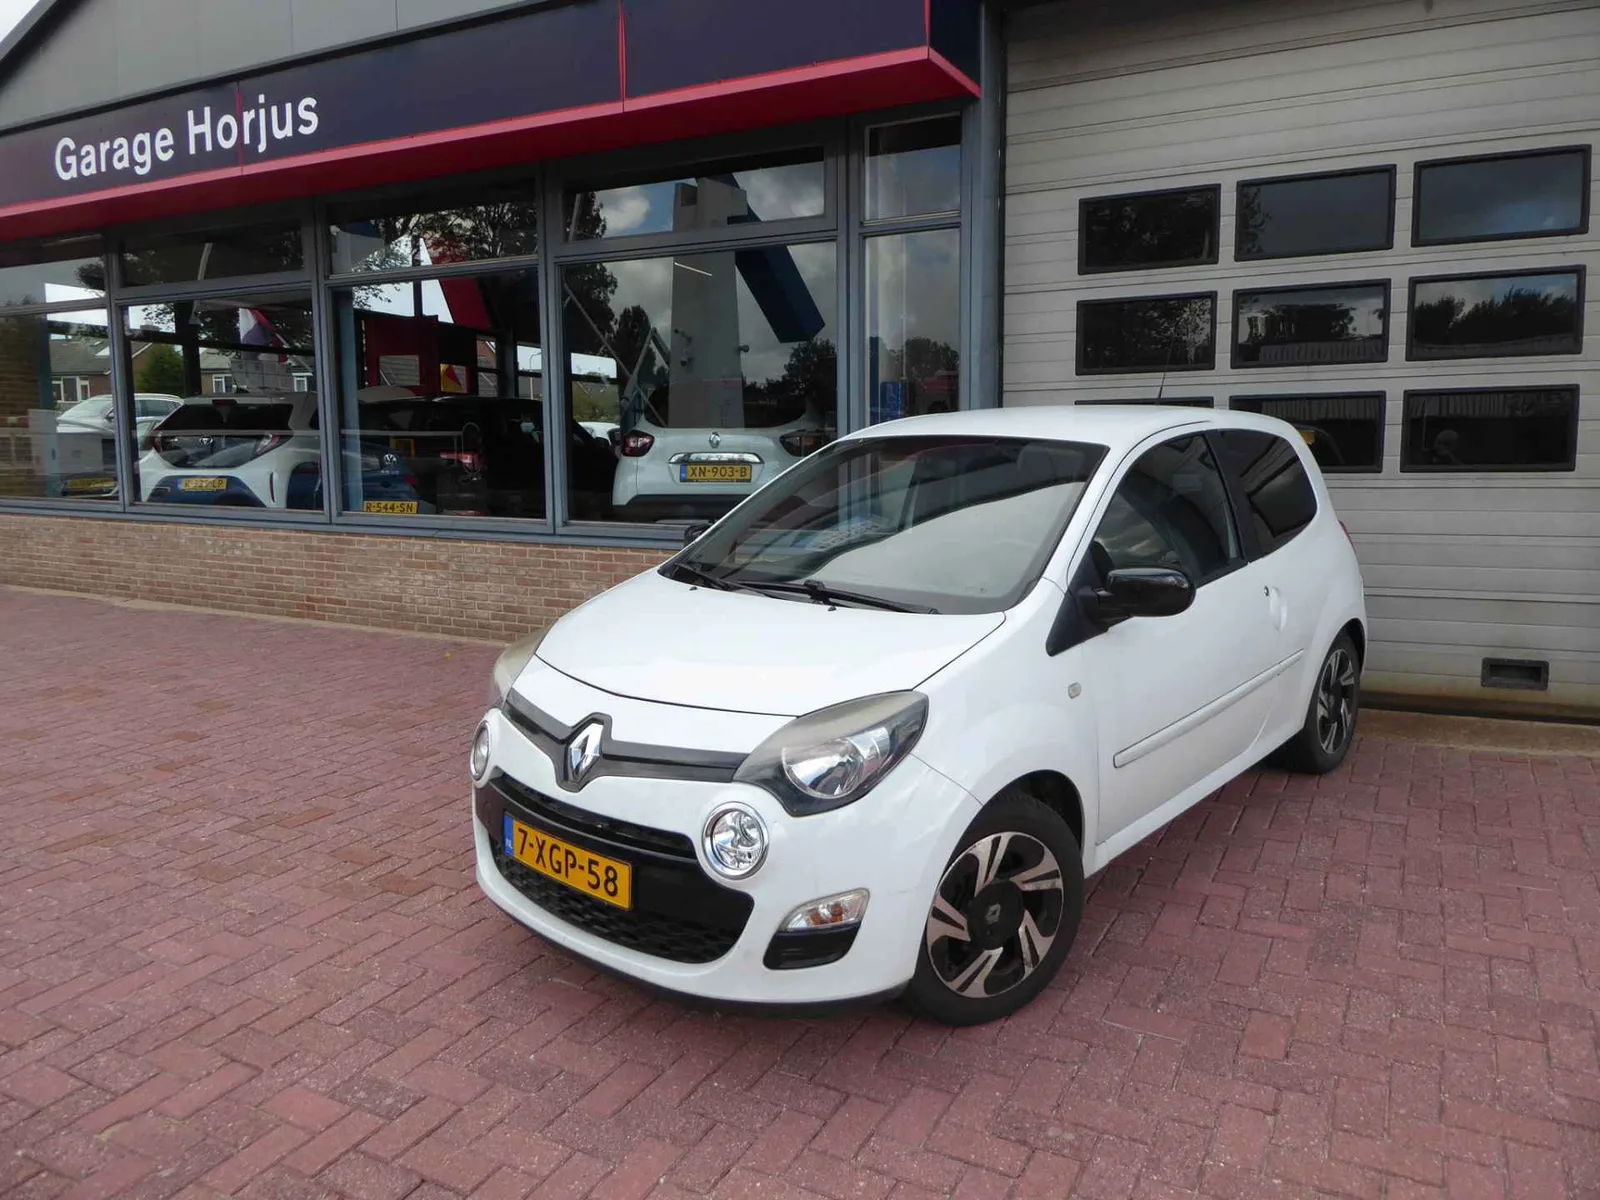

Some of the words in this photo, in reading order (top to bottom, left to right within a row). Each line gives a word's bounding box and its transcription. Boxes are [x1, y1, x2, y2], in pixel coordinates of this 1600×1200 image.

[54, 127, 175, 181] Garage
[187, 93, 319, 155] Horjus
[690, 466, 748, 478] XN-903-B
[366, 502, 414, 513] R-544-SN
[517, 827, 619, 898] 7-XGP-58
